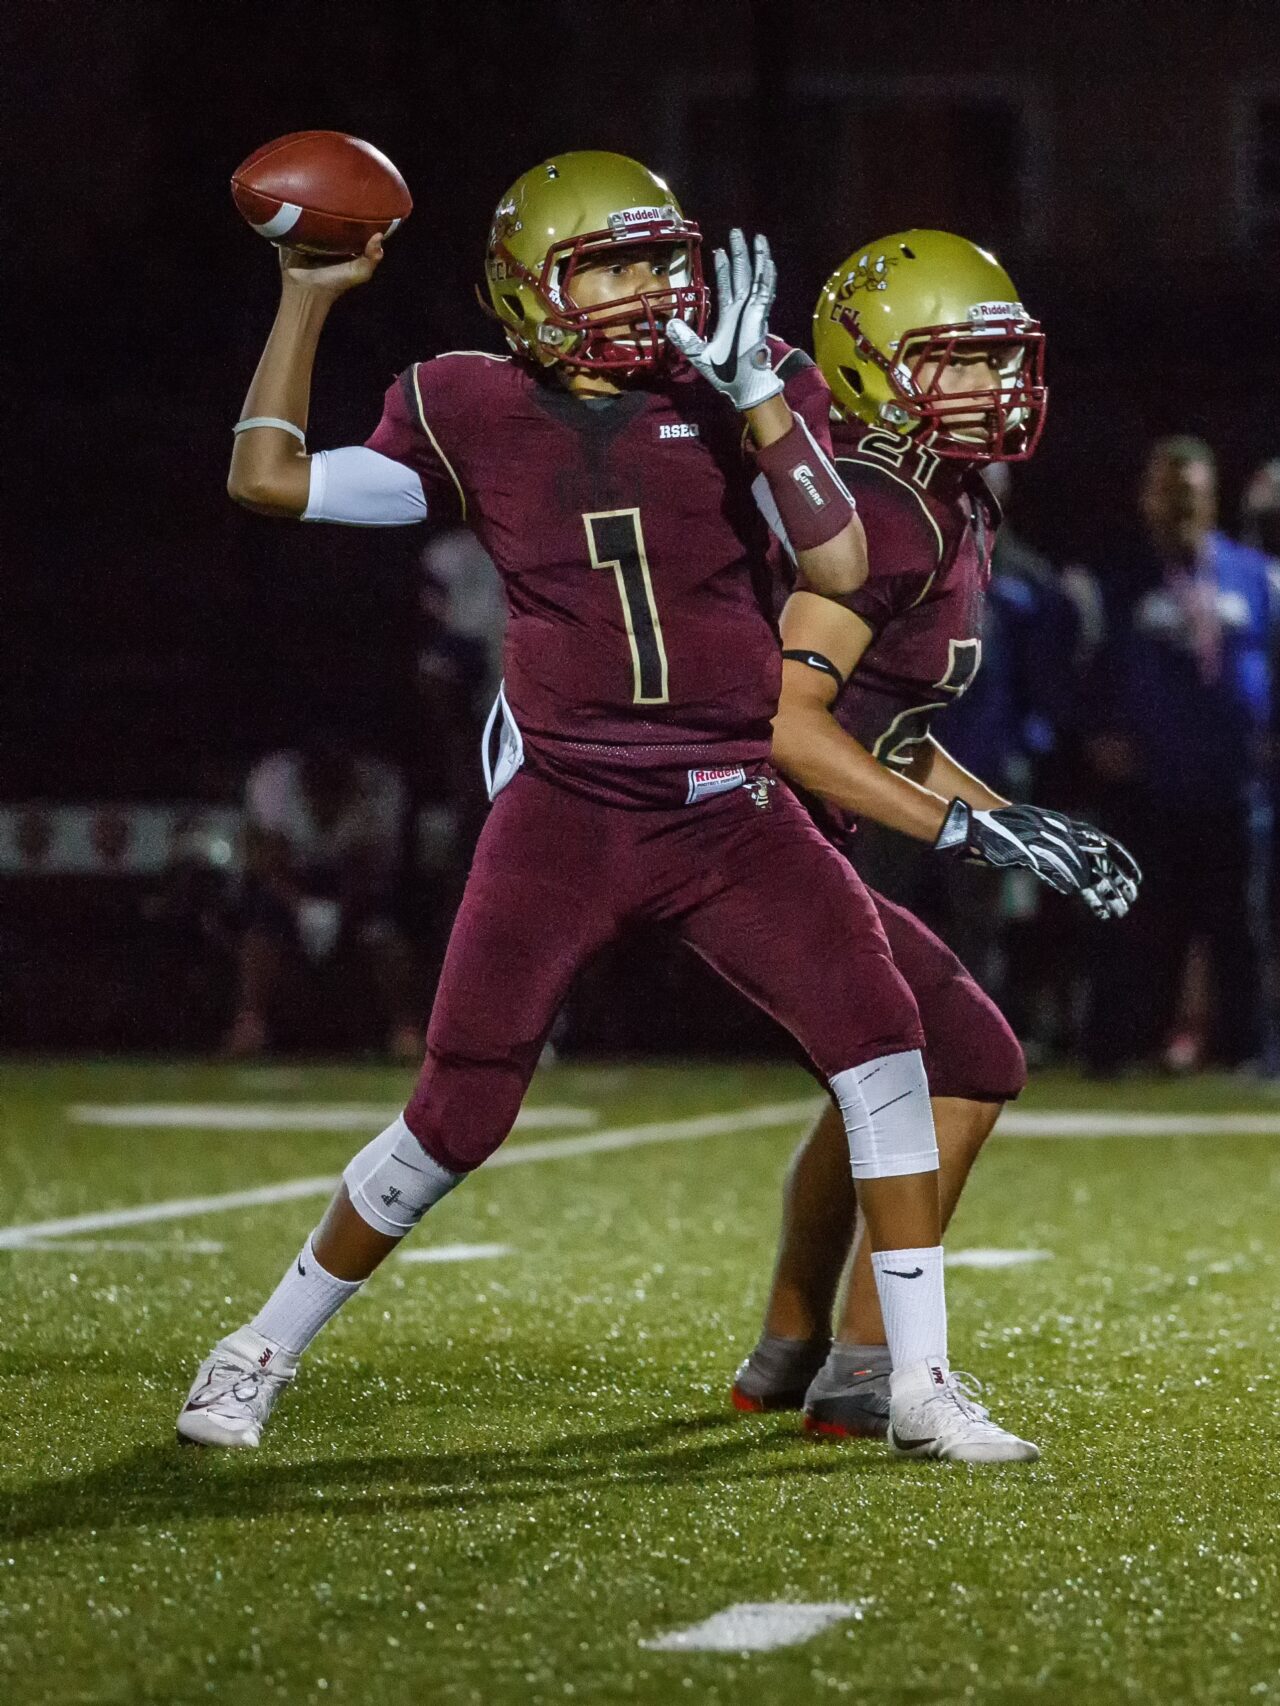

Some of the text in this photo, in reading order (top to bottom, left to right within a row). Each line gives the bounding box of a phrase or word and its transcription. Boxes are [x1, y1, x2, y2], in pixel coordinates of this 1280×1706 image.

[623, 208, 660, 222] Riddell
[857, 423, 943, 490] 21
[582, 507, 669, 705] 1
